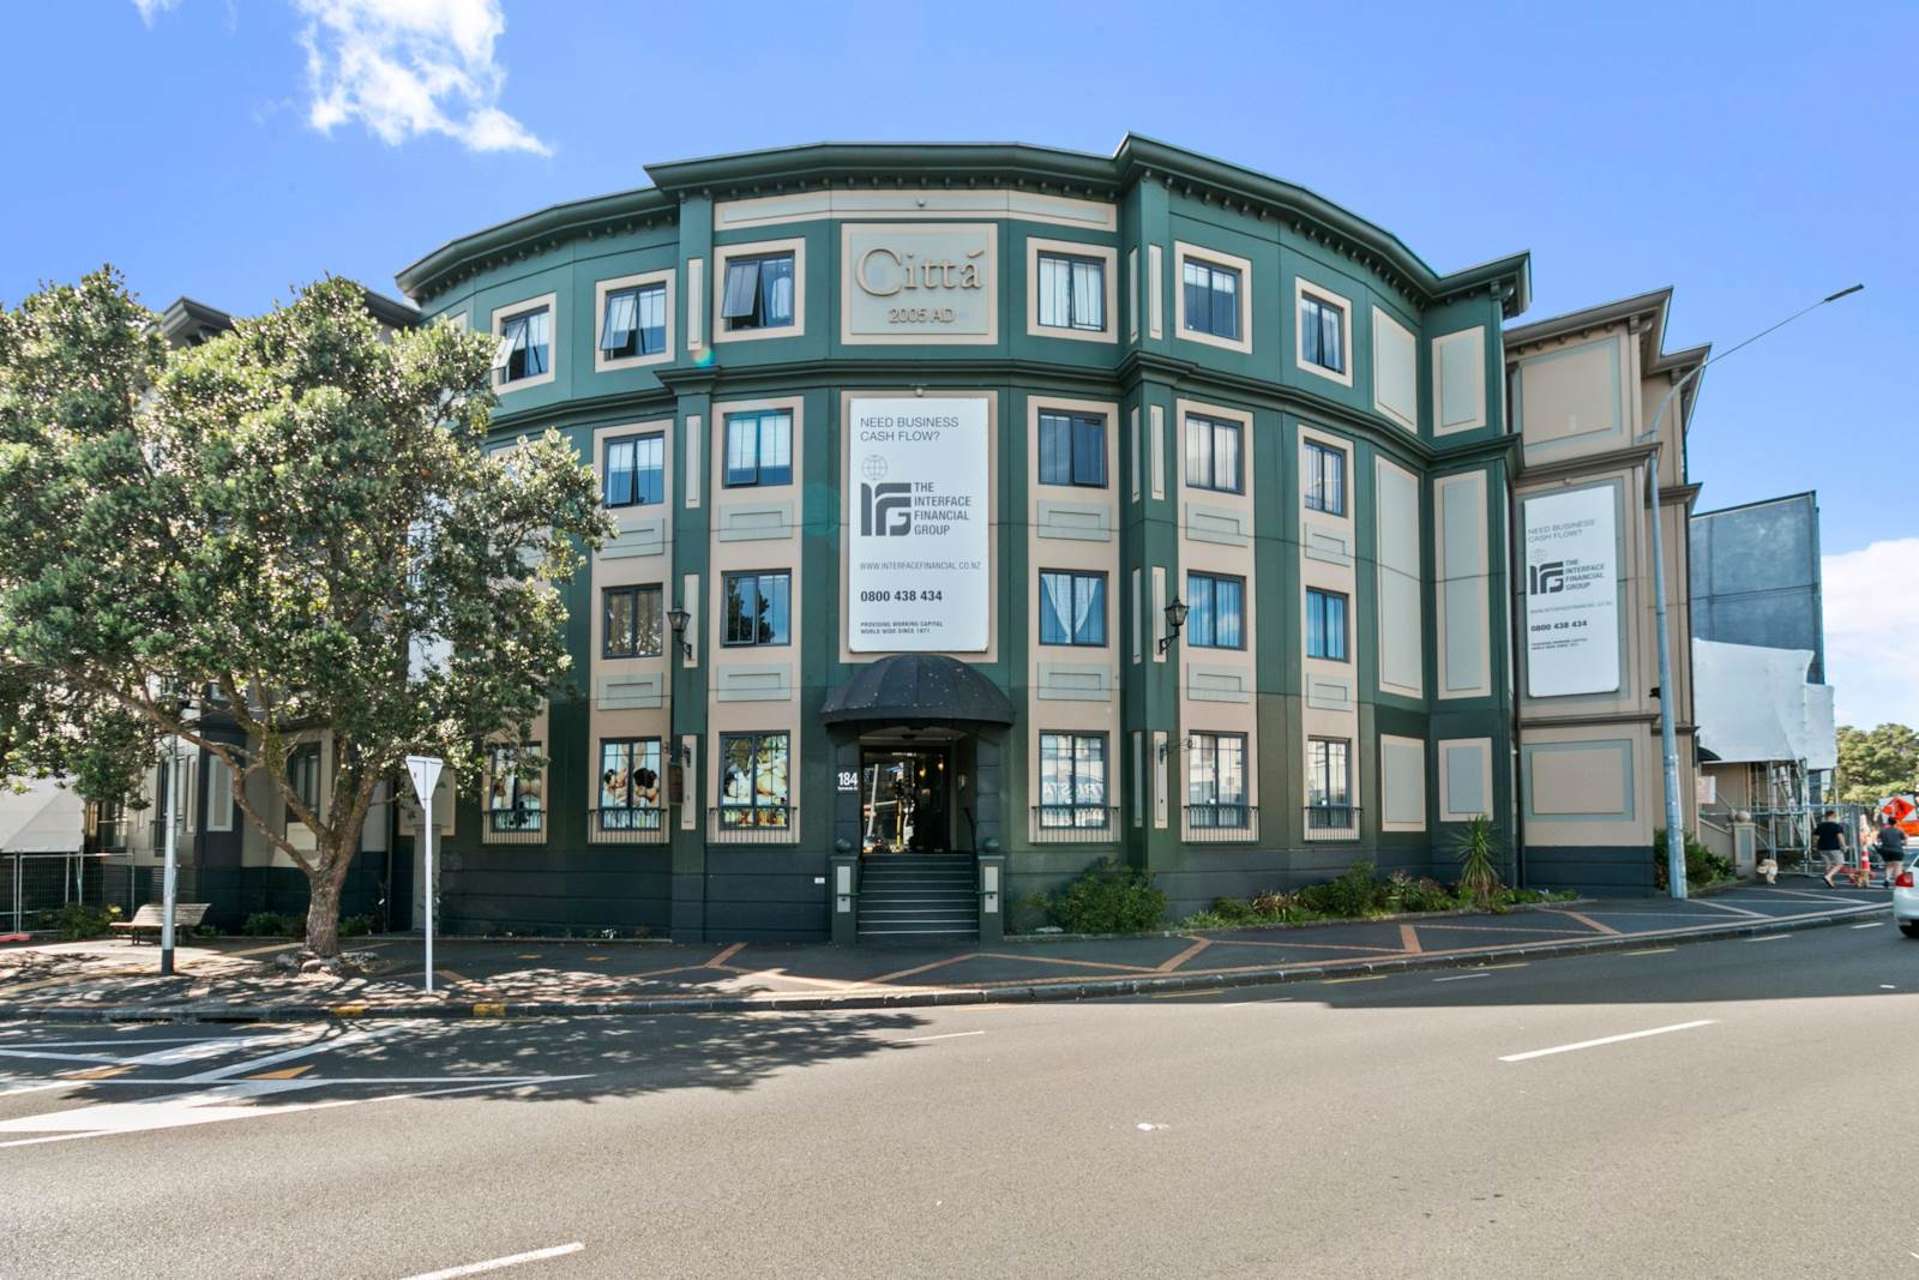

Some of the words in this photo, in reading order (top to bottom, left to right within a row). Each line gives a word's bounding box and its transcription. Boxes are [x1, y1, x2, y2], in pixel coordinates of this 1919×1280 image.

[855, 248, 984, 297] Cittá
[888, 308, 928, 324] 2005
[929, 308, 955, 324] AD
[860, 416, 894, 428] NEED
[897, 416, 960, 428] BUSINESS
[860, 431, 894, 441] CASH
[898, 431, 941, 441] FLOW?
[914, 482, 935, 493] THE
[914, 496, 972, 507] INTERFACE
[914, 510, 970, 521] FINANCIAL
[914, 524, 951, 536] GROUP
[1527, 526, 1551, 535] NEED
[1552, 519, 1596, 532] BUSINESS
[1527, 534, 1552, 543] CASH
[1565, 558, 1579, 566] THE
[1565, 563, 1605, 574] INTERFACE
[1565, 573, 1605, 583] FINANCIAL
[1565, 582, 1591, 591] GROUP
[860, 590, 891, 602] 0800
[894, 590, 917, 602] 438
[920, 590, 943, 602] 434
[837, 771, 859, 786] 184
